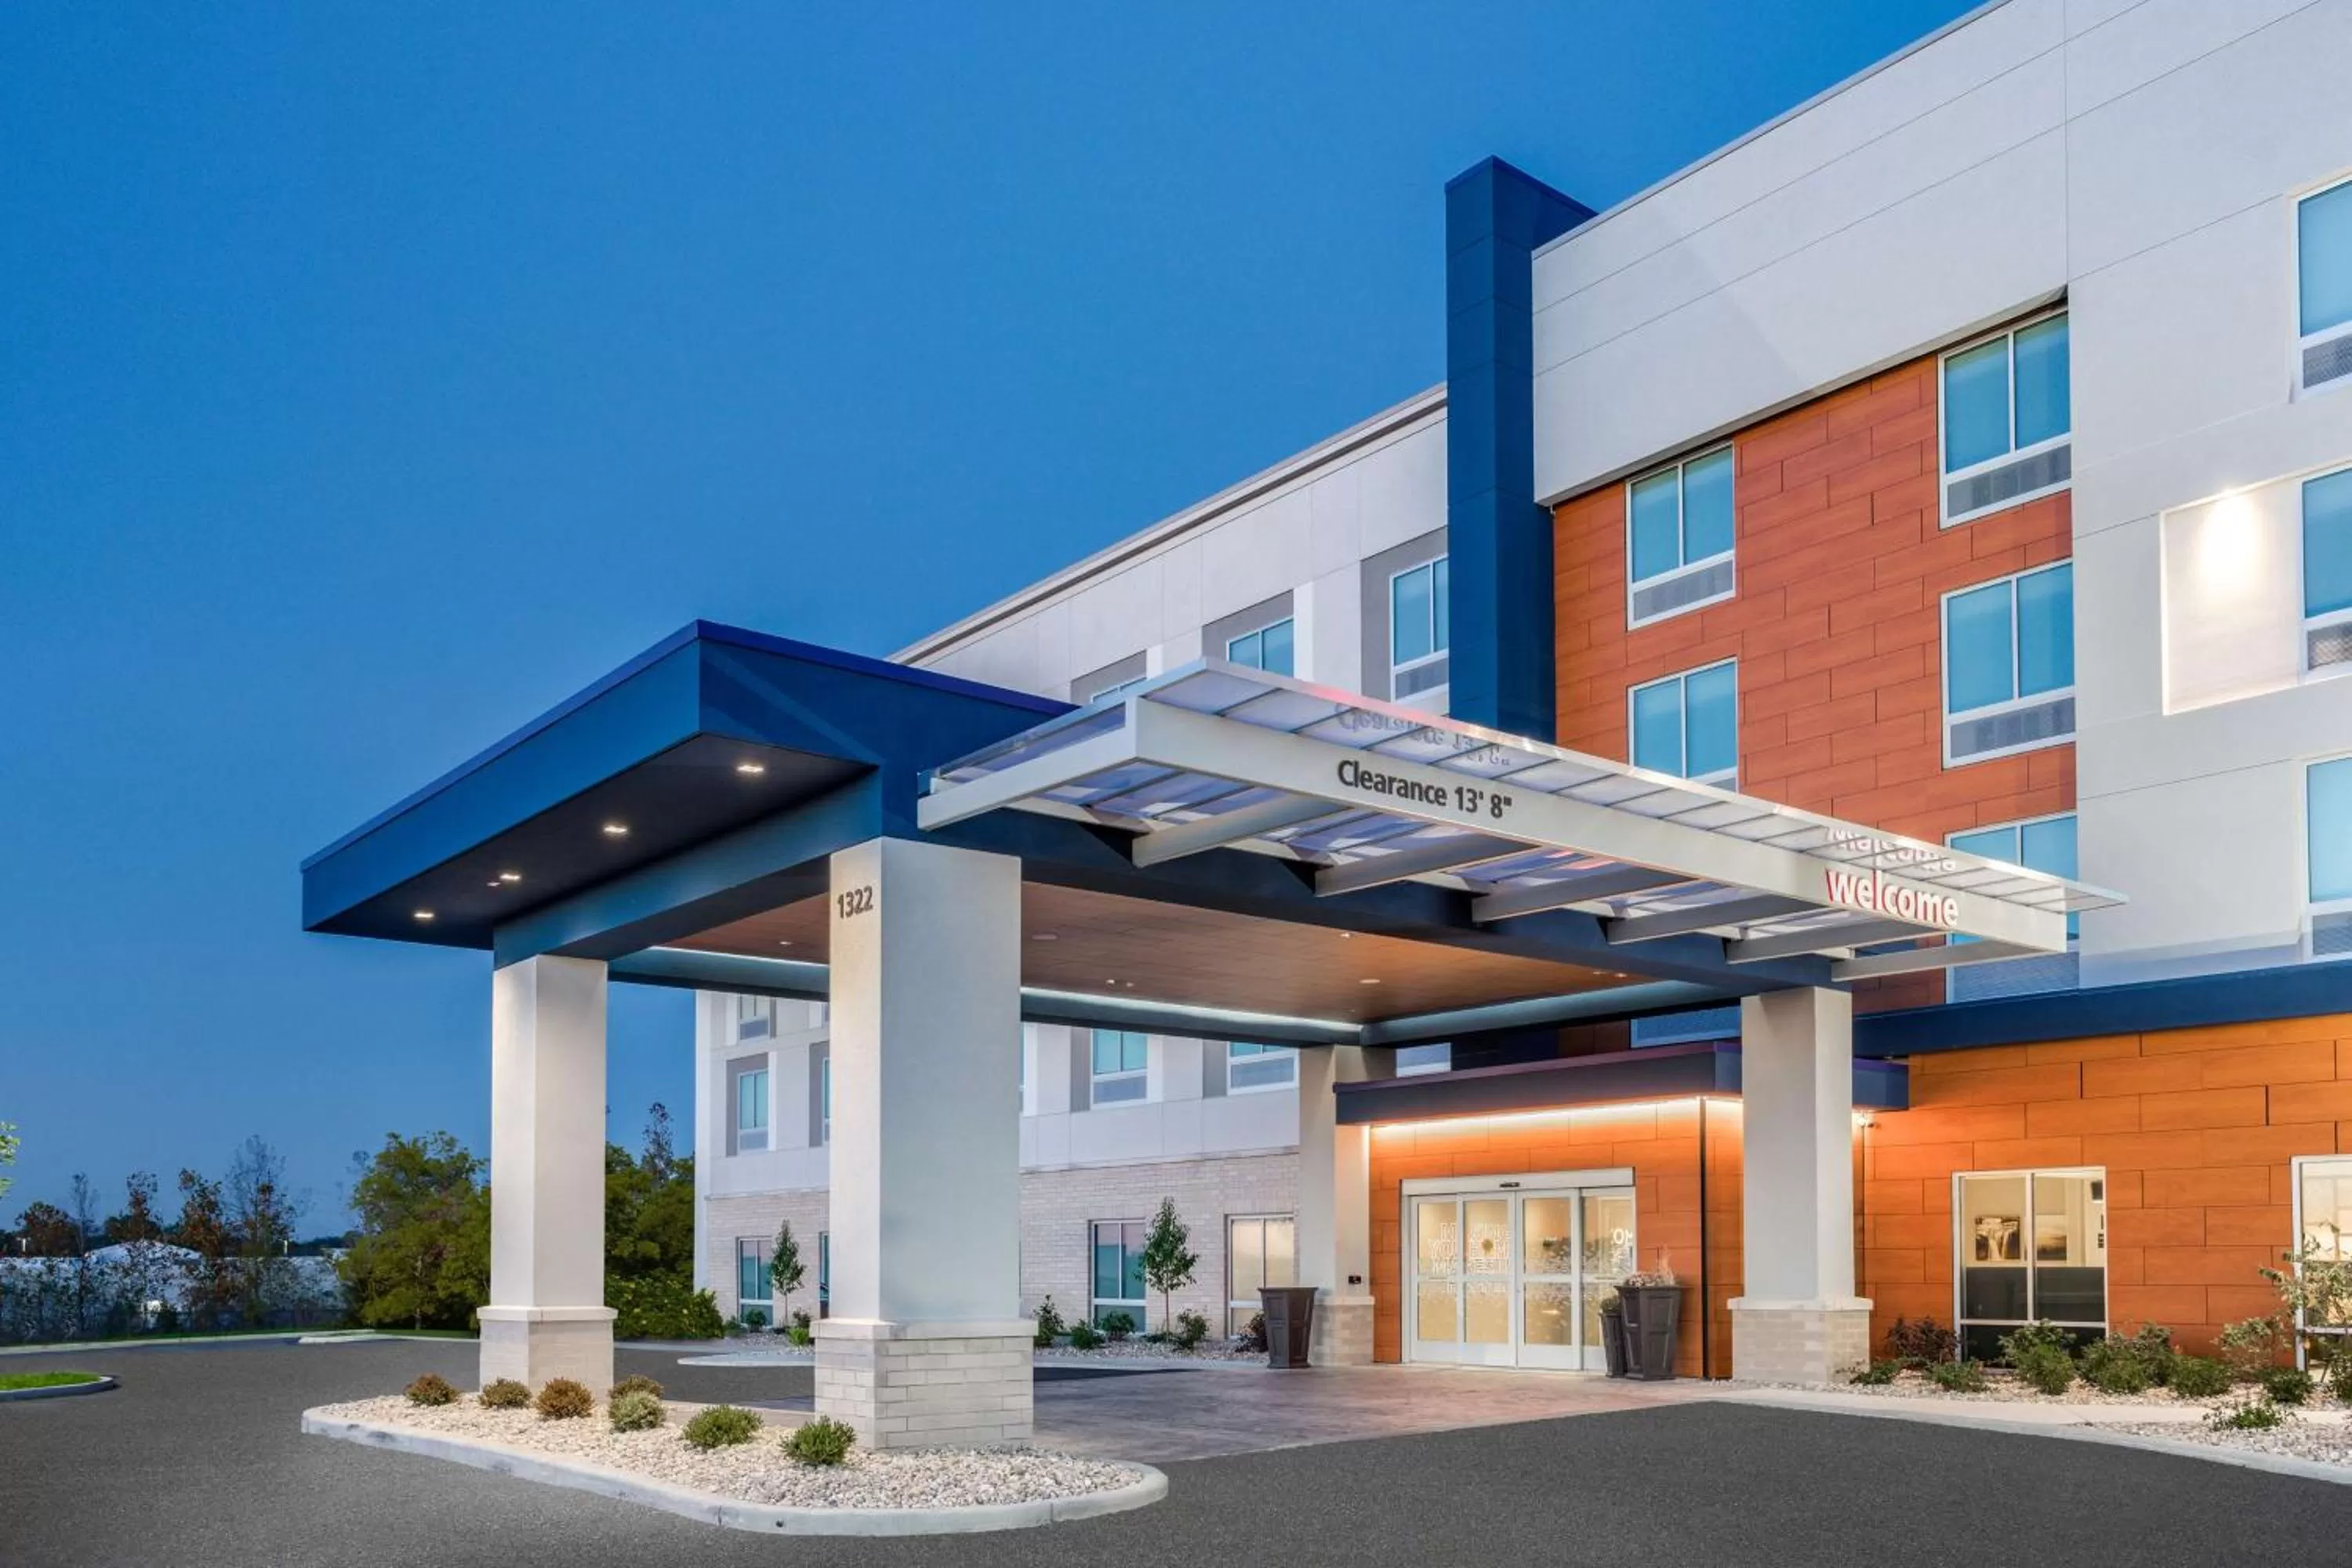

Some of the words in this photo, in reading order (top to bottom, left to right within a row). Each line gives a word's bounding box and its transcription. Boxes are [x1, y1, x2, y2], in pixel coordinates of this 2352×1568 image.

[1338, 760, 1448, 806] Clearance
[1454, 786, 1484, 813] 13'
[1490, 793, 1512, 818] 8"
[837, 886, 873, 919] 1322
[1825, 867, 1958, 926] welcome
